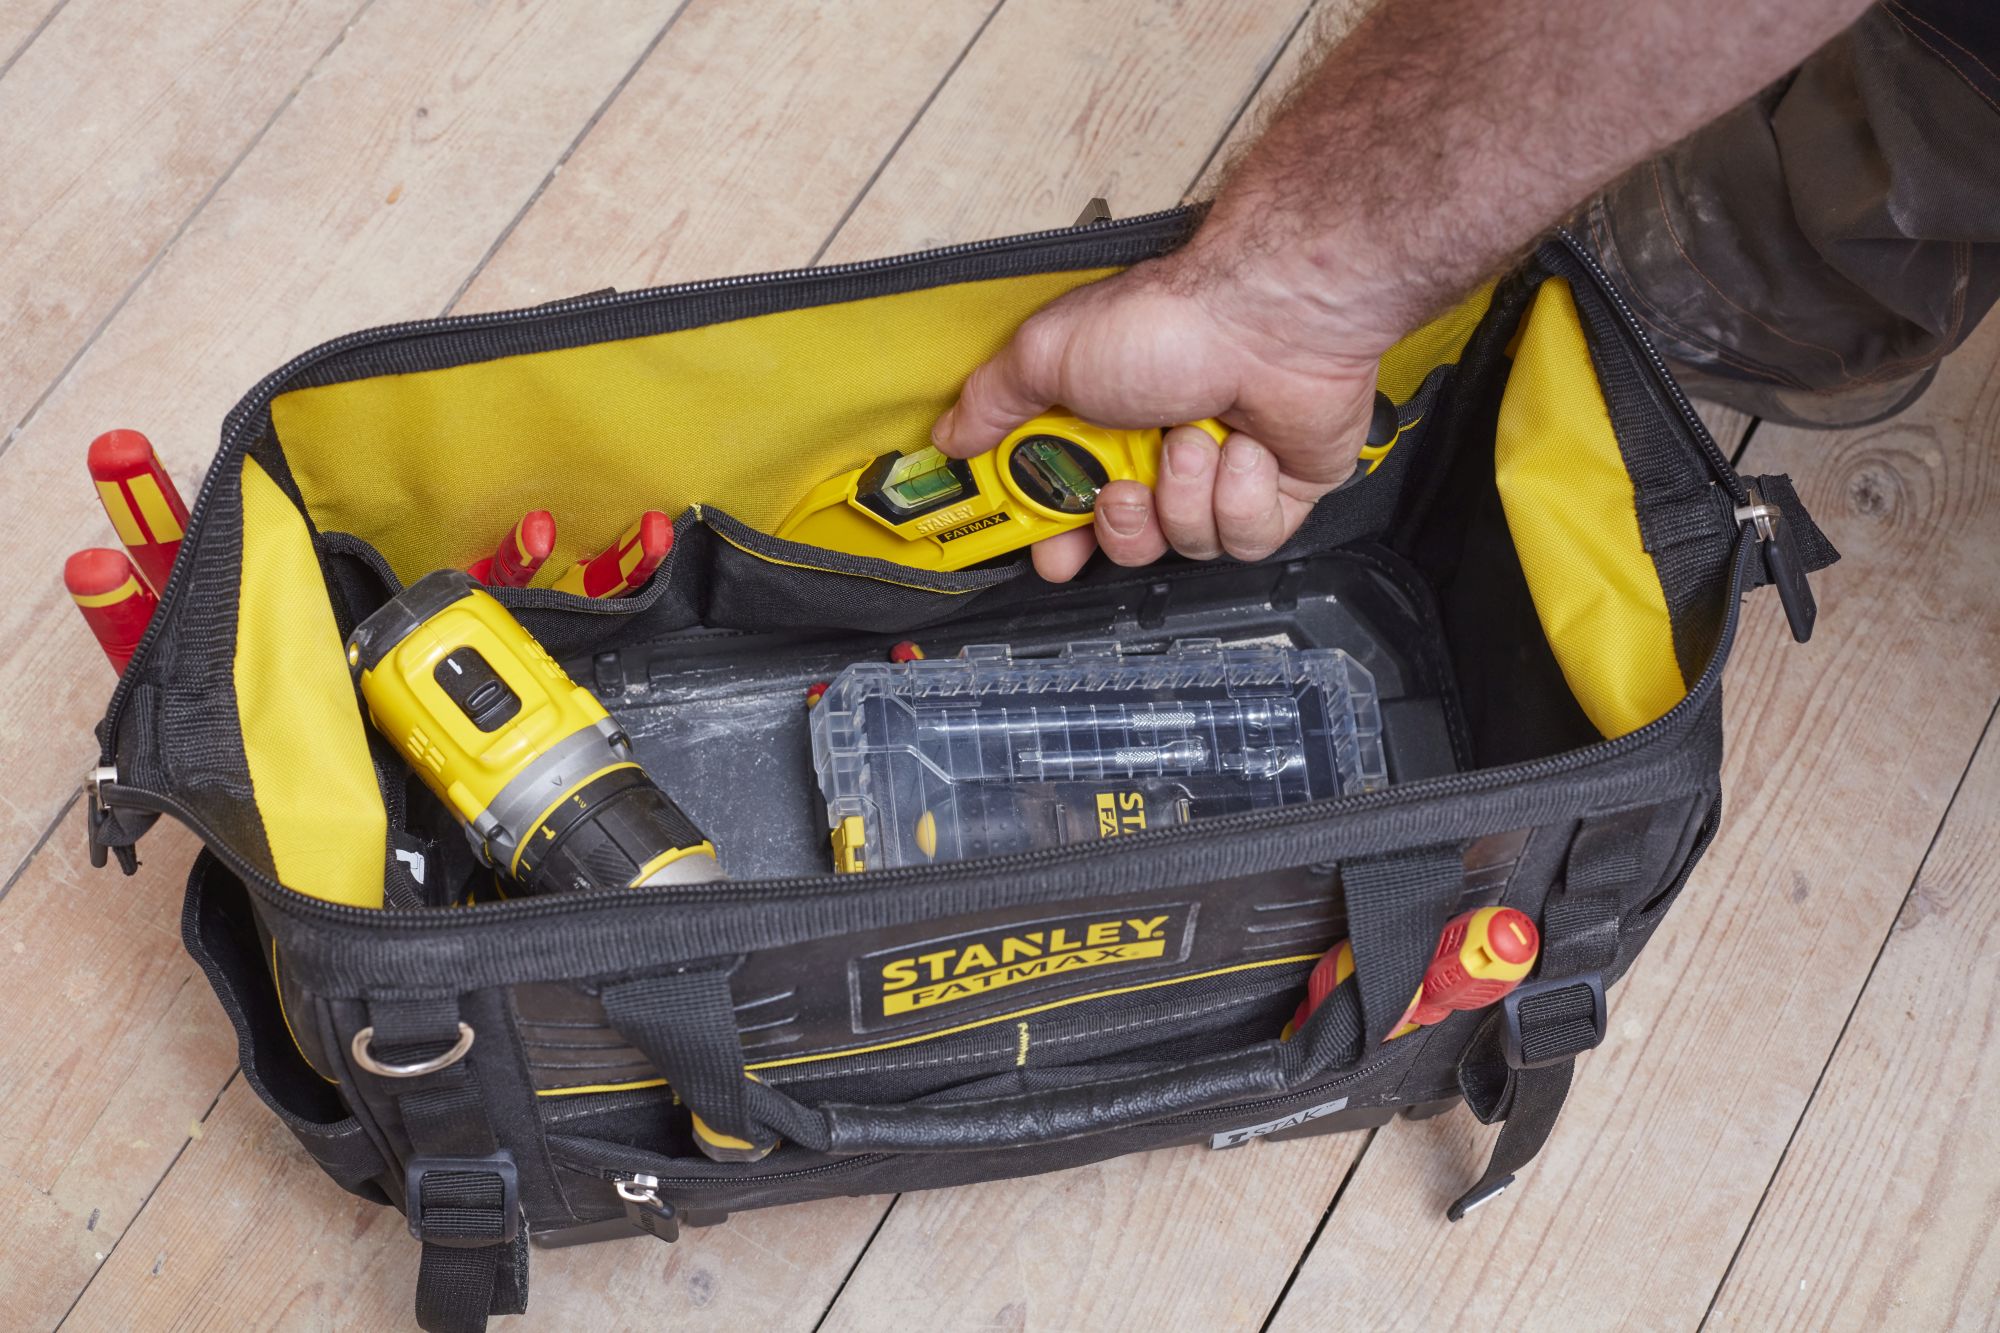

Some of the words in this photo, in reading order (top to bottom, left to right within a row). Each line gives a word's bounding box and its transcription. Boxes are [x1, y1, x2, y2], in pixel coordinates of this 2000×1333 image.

[915, 504, 975, 535] STANLEY
[944, 514, 1004, 541] FATMAX
[1100, 807, 1117, 839] FA
[1120, 792, 1147, 834] ST
[882, 915, 1170, 991] STANLEY
[912, 947, 1126, 1006] FATMAX
